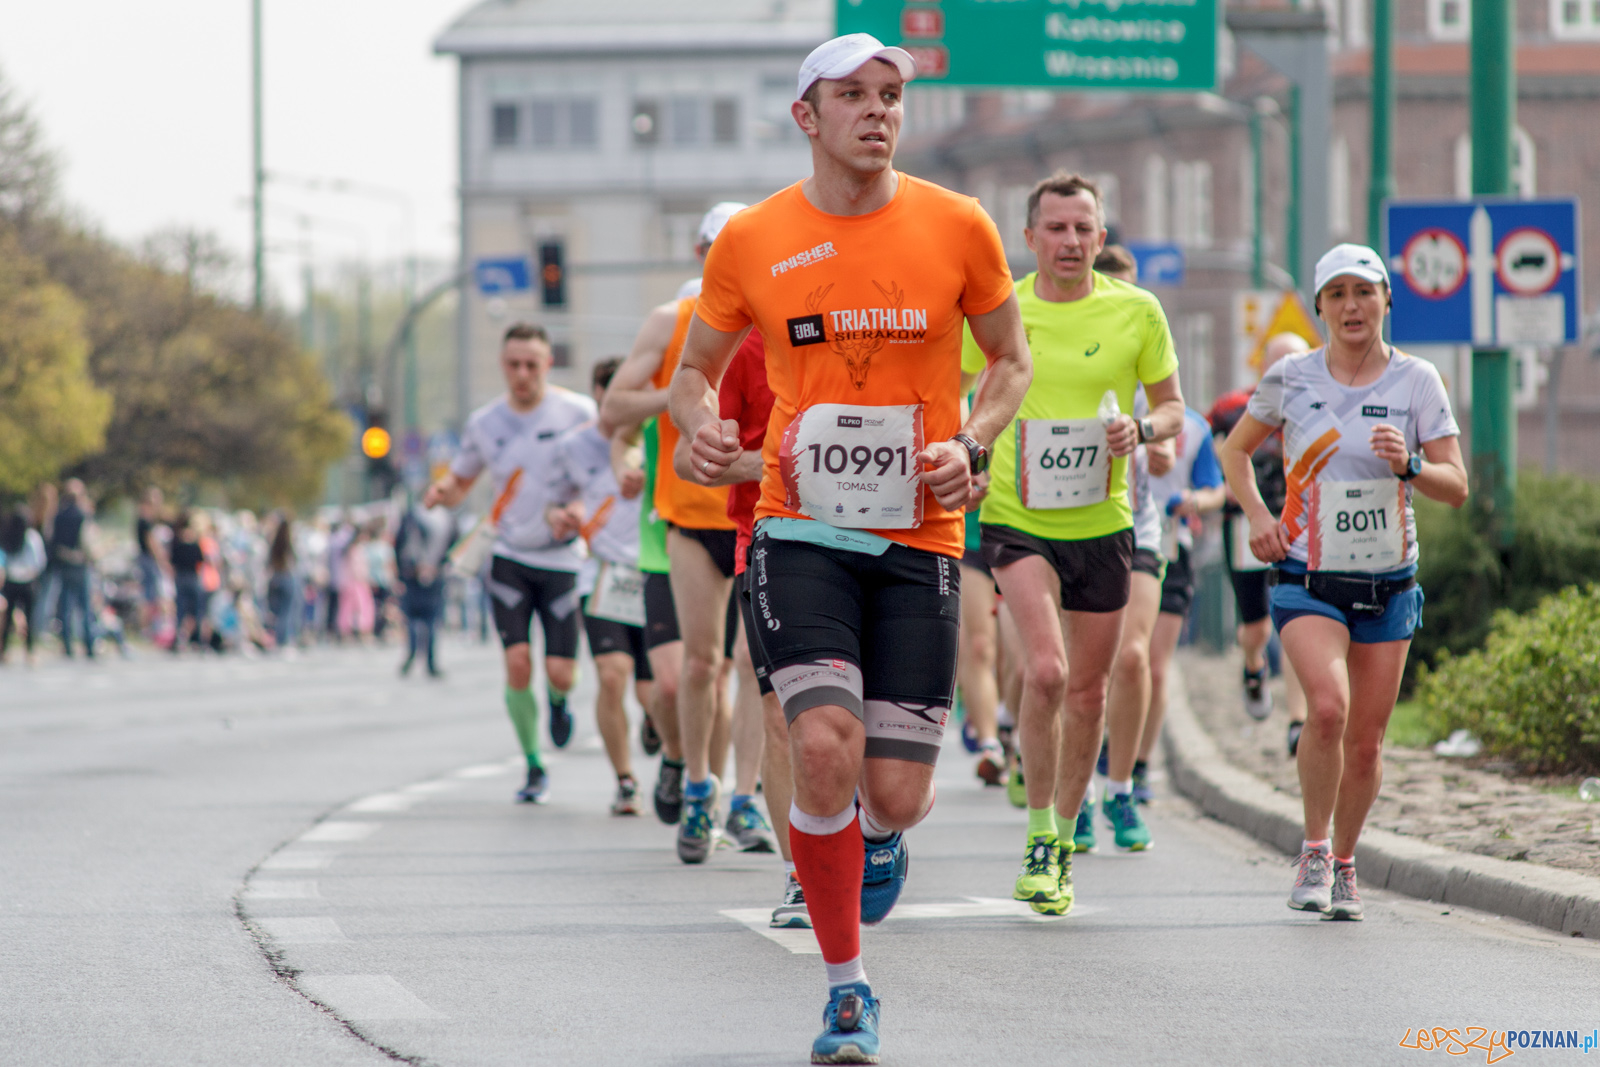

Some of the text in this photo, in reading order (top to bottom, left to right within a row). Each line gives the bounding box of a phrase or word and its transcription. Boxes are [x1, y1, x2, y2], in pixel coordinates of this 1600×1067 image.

[1044, 12, 1186, 43] Katowice
[770, 241, 836, 277] FINISHER
[796, 322, 820, 340] JBL
[830, 308, 927, 332] TRIATHLON
[808, 443, 907, 476] 10991
[1040, 445, 1098, 469] 6677
[836, 482, 879, 492] TOMASZ
[1336, 507, 1387, 532] 8011
[758, 592, 771, 619] euco
